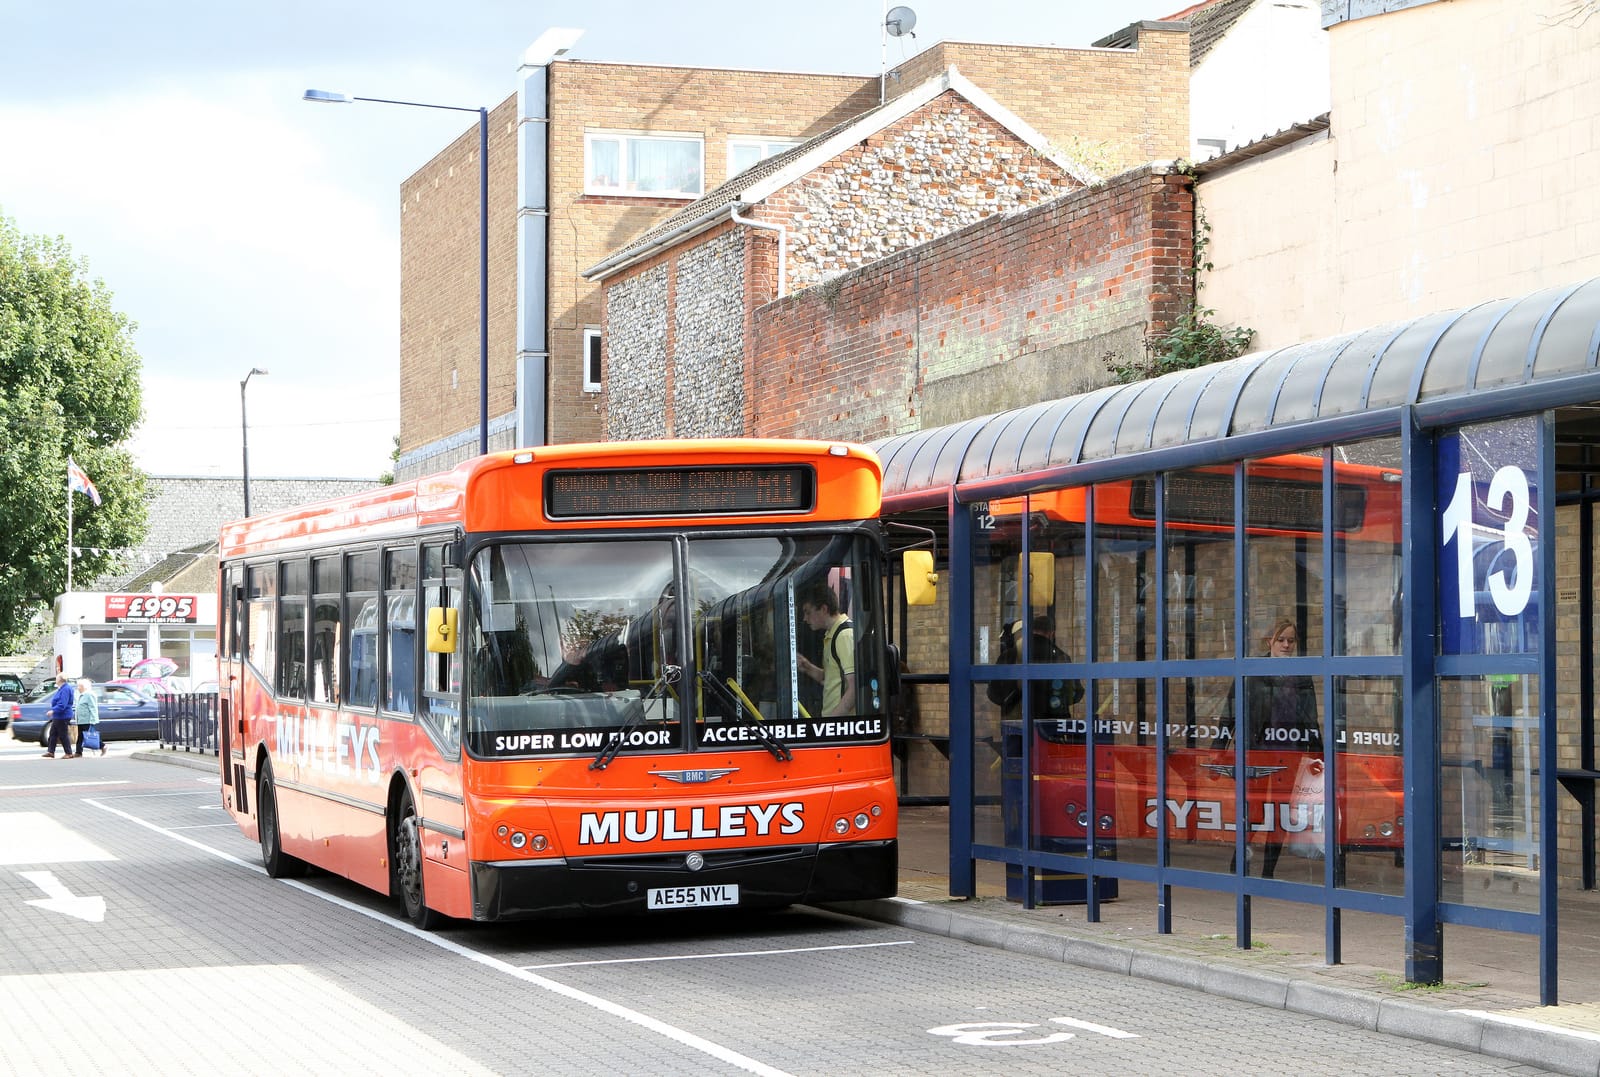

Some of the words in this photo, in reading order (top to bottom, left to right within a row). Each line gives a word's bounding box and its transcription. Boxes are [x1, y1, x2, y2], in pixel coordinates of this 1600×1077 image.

[648, 472, 681, 490] TOWN
[688, 470, 754, 489] CIRCULAR
[973, 502, 1000, 512] STAND
[977, 514, 996, 529] 12
[1443, 465, 1534, 617] 13
[127, 597, 193, 617] £995
[495, 734, 555, 750] SUPER
[561, 732, 604, 748] LOW
[609, 730, 671, 746] FLOOR
[703, 723, 807, 742] ACCESSIBLE
[812, 719, 881, 738] VEHICLE
[277, 714, 380, 783] MULLEYS
[685, 771, 704, 781] BMC
[579, 802, 804, 845] MULLEYS
[655, 887, 696, 905] AE55
[700, 886, 732, 902] NYL
